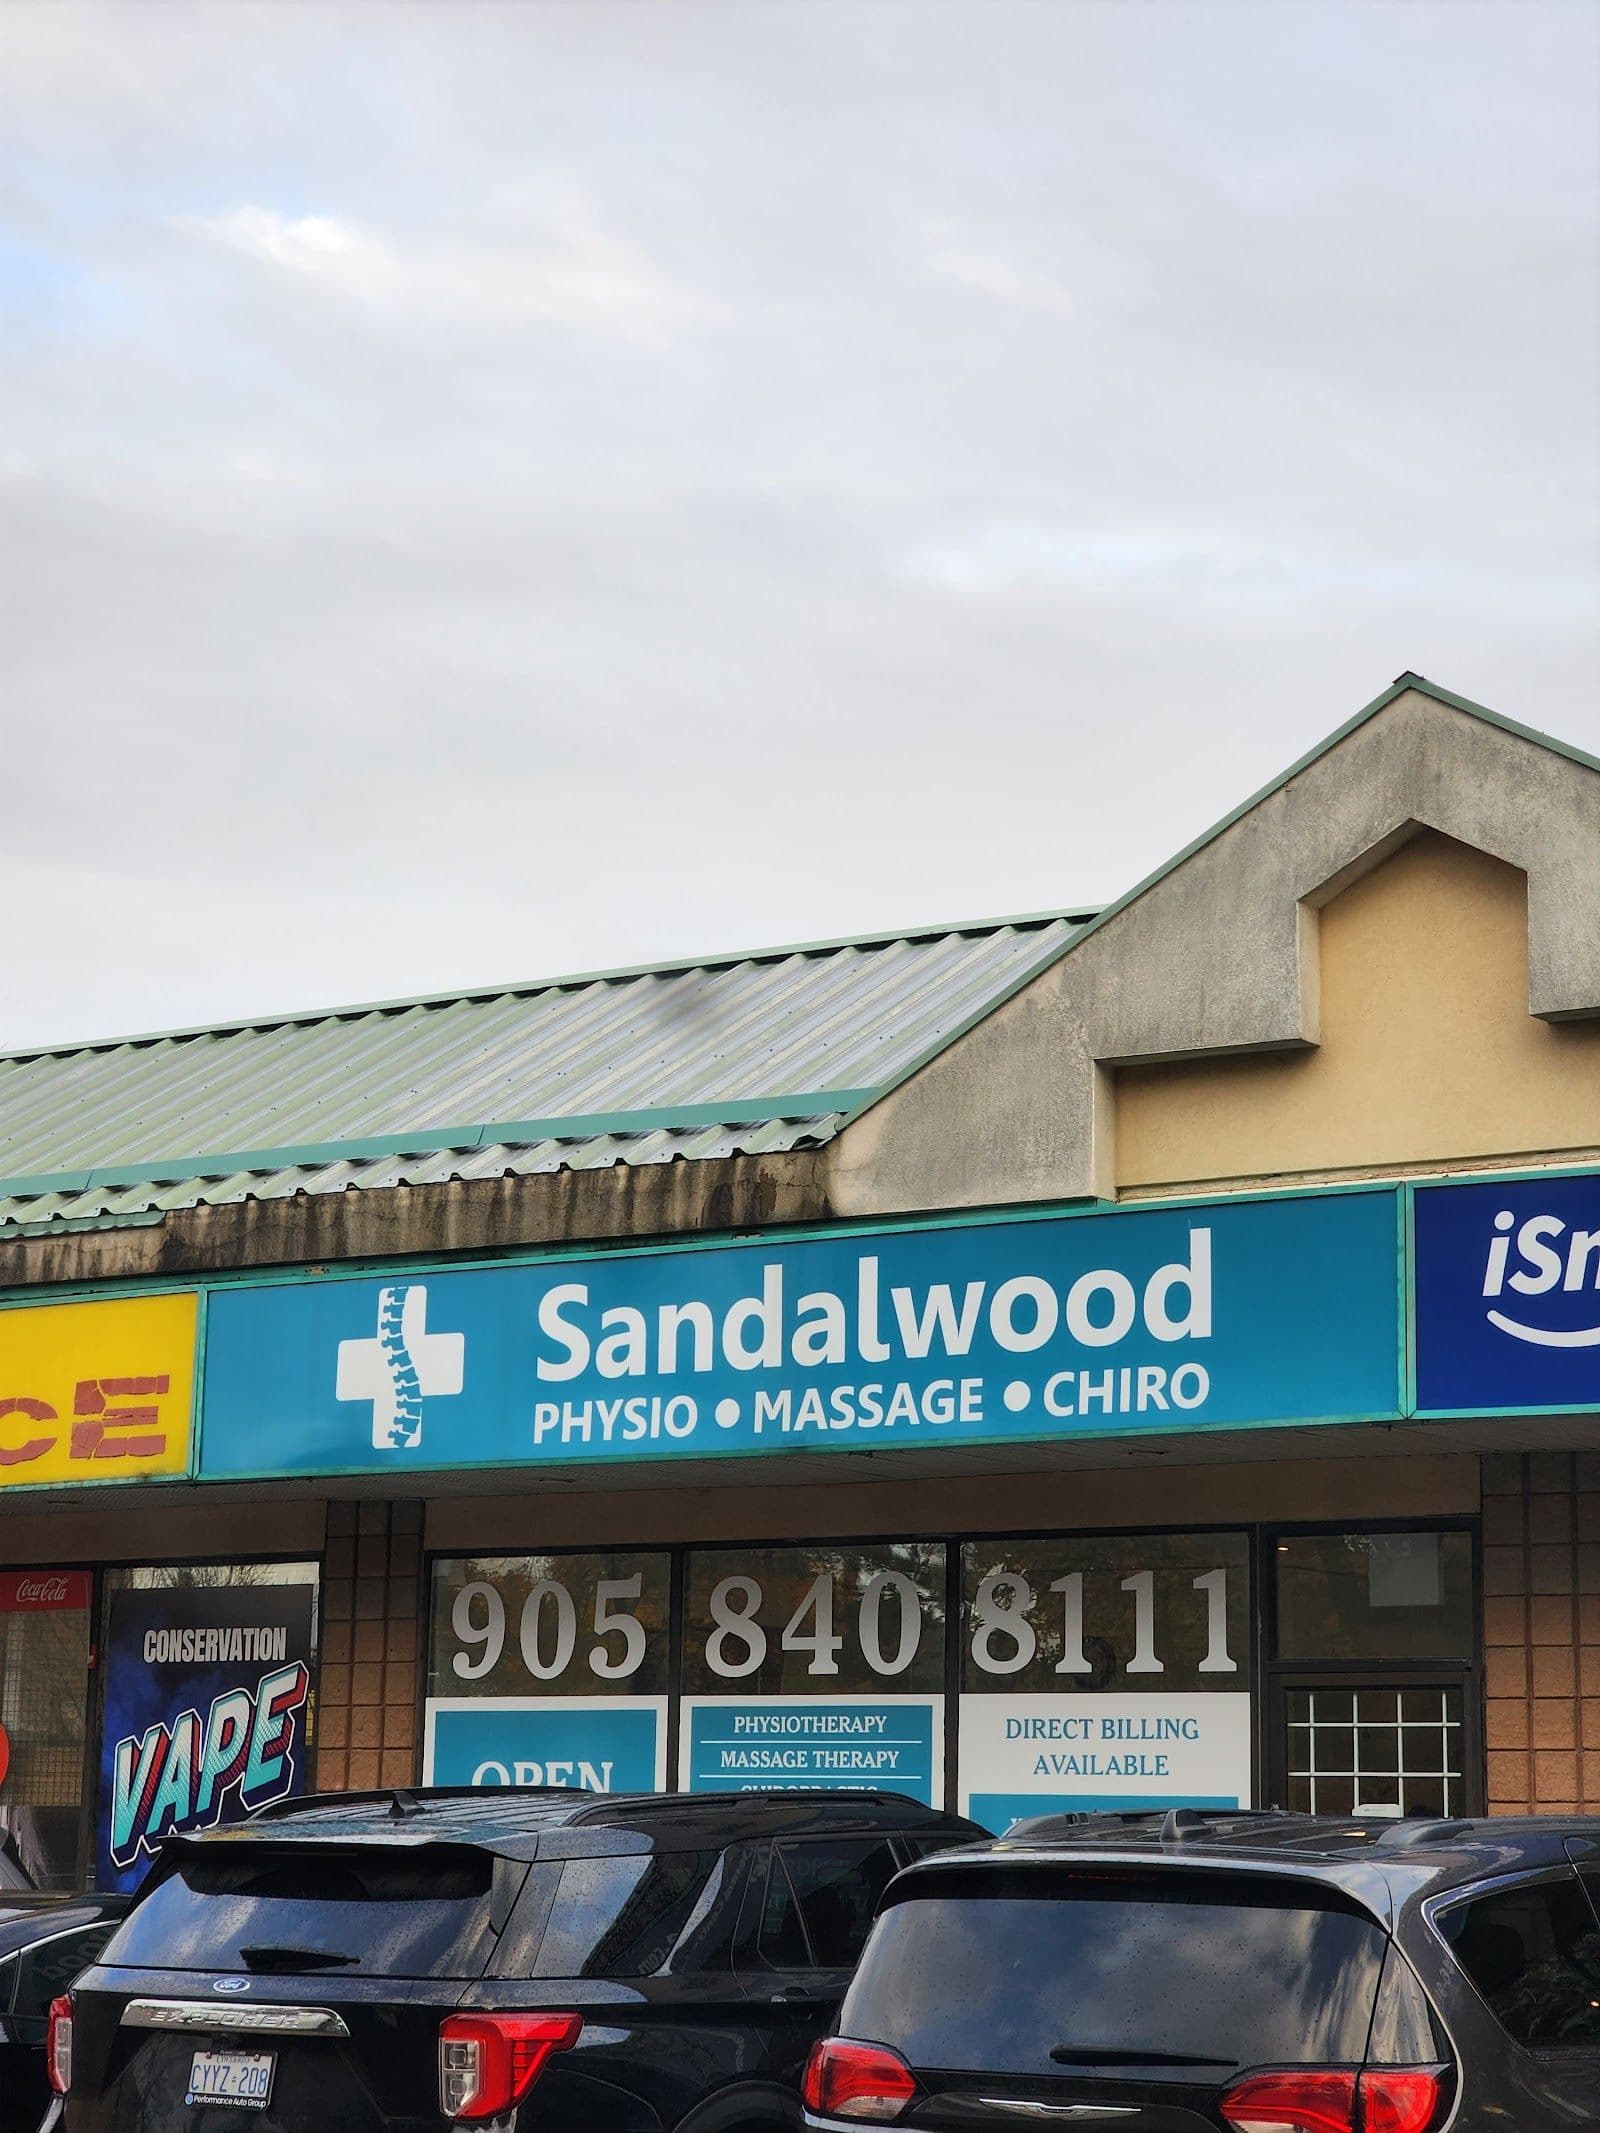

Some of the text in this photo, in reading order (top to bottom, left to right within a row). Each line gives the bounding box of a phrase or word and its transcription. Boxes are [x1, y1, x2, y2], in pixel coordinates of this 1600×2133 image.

[537, 1227, 1212, 1382] Sandalwood
[533, 1362, 1210, 1444] PHYSIO MASSAGE CHIRO
[451, 1568, 1237, 1680] 905 840 8111
[143, 1627, 287, 1663] CONSERVATION
[733, 1715, 888, 1734] PHYSIOTHERAPY
[1005, 1718, 1200, 1741] DIRECT BILLING
[111, 1660, 309, 1868] VAPE
[720, 1750, 900, 1769] MASSAGE THERAPY
[1033, 1754, 1169, 1776] AVAILABLE
[471, 1761, 613, 1794] OPEN
[233, 2098, 247, 2106] Auto
[247, 2099, 266, 2109] Group
